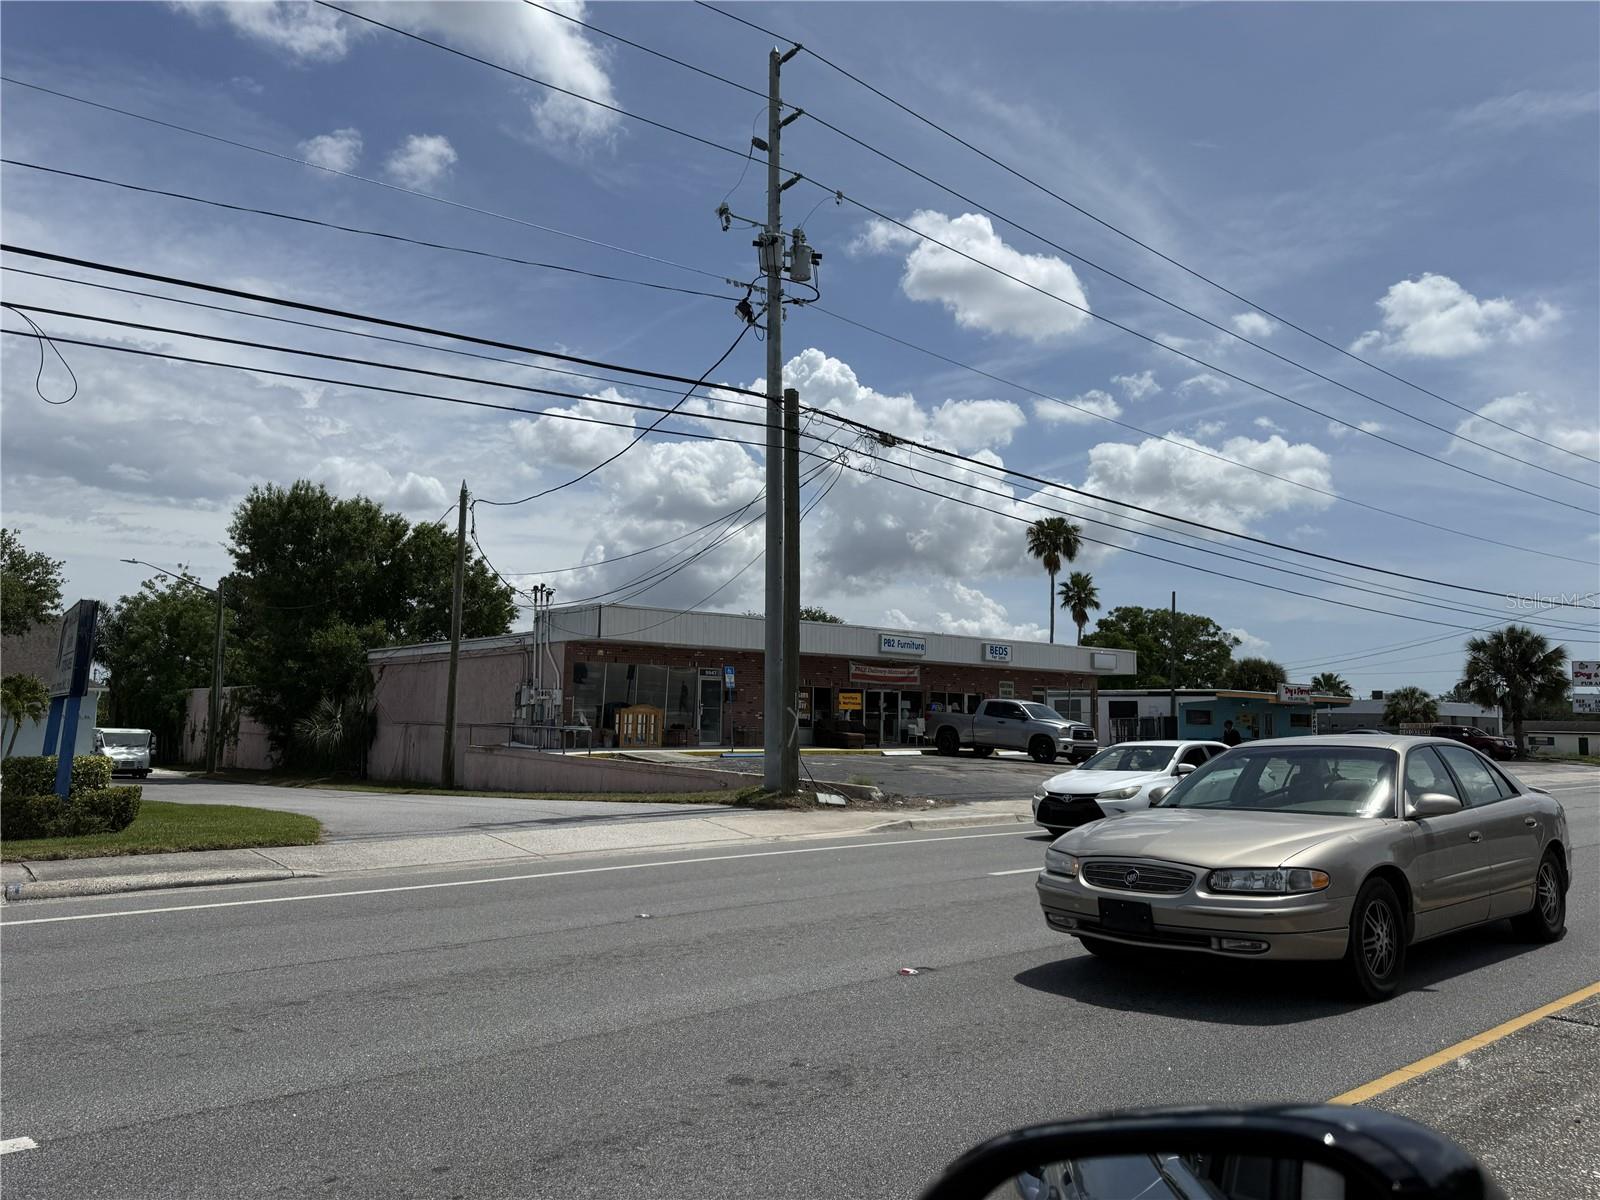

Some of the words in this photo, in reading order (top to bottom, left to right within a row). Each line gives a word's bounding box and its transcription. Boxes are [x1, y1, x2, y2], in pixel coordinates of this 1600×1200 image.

[897, 639, 925, 651] Furniture
[989, 645, 1009, 656] BEDS
[1573, 671, 1592, 679] Dog
